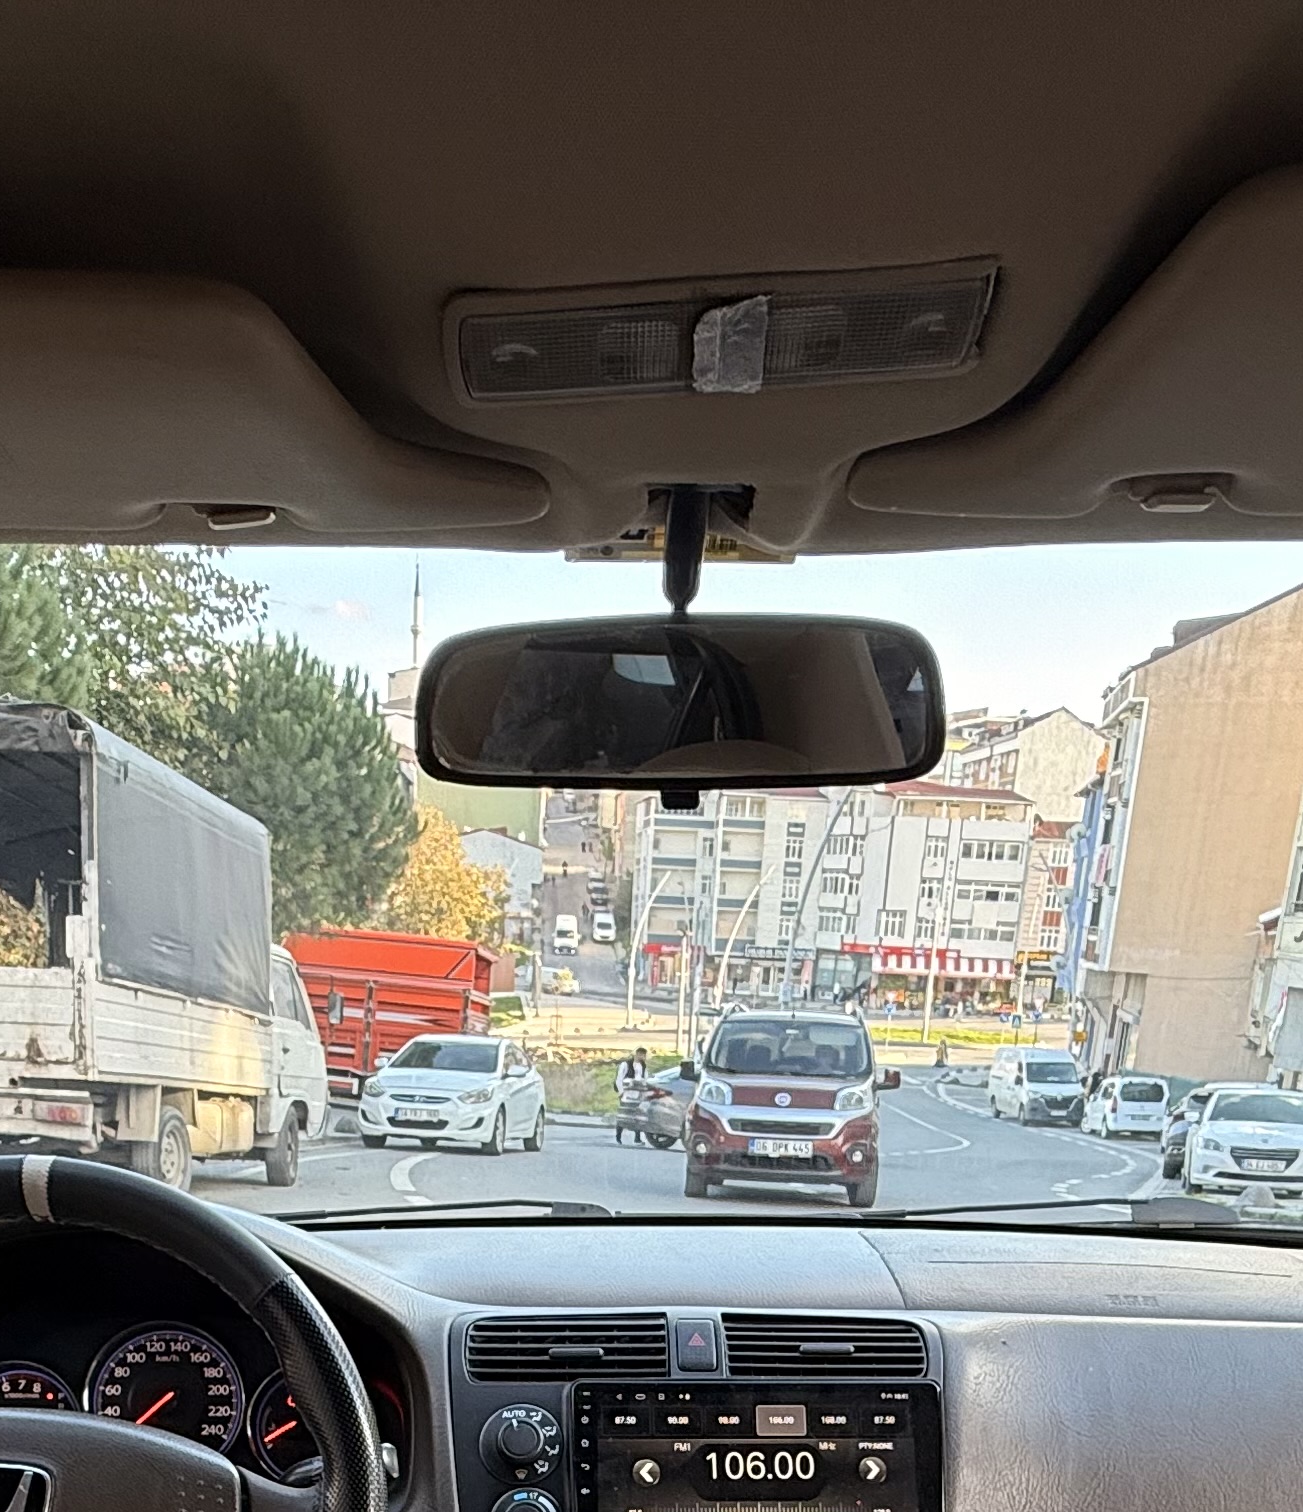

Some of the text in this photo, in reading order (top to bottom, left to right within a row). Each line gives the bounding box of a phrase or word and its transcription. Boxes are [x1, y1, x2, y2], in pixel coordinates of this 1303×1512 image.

[793, 1143, 810, 1154] 445
[146, 1341, 166, 1352] 120
[170, 1342, 191, 1352] 140
[126, 1352, 146, 1363] 100
[156, 1354, 180, 1362] km/h
[190, 1353, 210, 1363] 160
[114, 1367, 130, 1378] 80
[203, 1367, 223, 1378] 180
[1, 1382, 11, 1392] 6
[18, 1380, 26, 1390] 7
[32, 1382, 41, 1393] 8
[105, 1385, 121, 1396] 60
[207, 1385, 229, 1396] 200
[104, 1406, 120, 1417] 40
[208, 1406, 230, 1417] 220
[502, 1410, 526, 1418] AUTO
[201, 1424, 224, 1435] 240
[705, 1451, 816, 1481] 106.00
